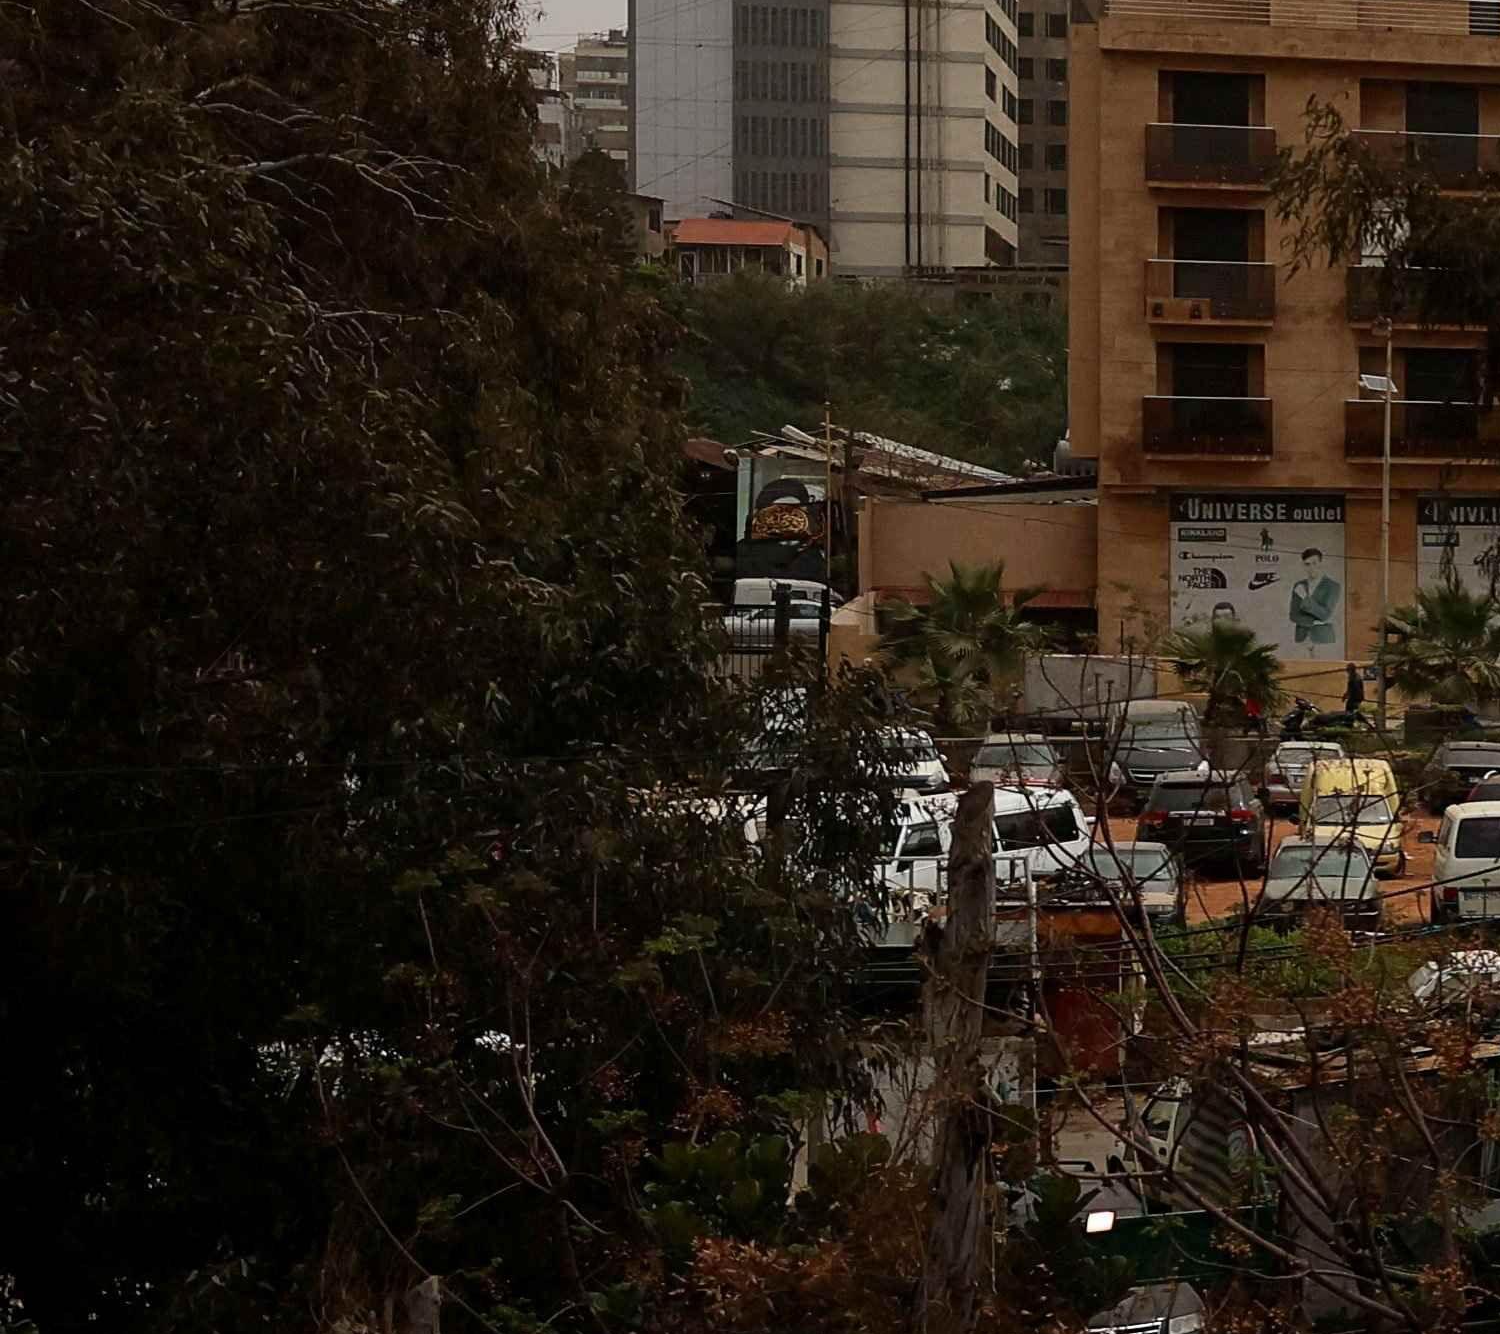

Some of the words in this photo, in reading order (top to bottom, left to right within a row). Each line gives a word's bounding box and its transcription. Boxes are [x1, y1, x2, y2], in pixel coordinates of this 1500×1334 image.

[1187, 497, 1288, 521] UNIVERSE
[1293, 505, 1343, 521] outlet
[1255, 554, 1280, 564] POLO
